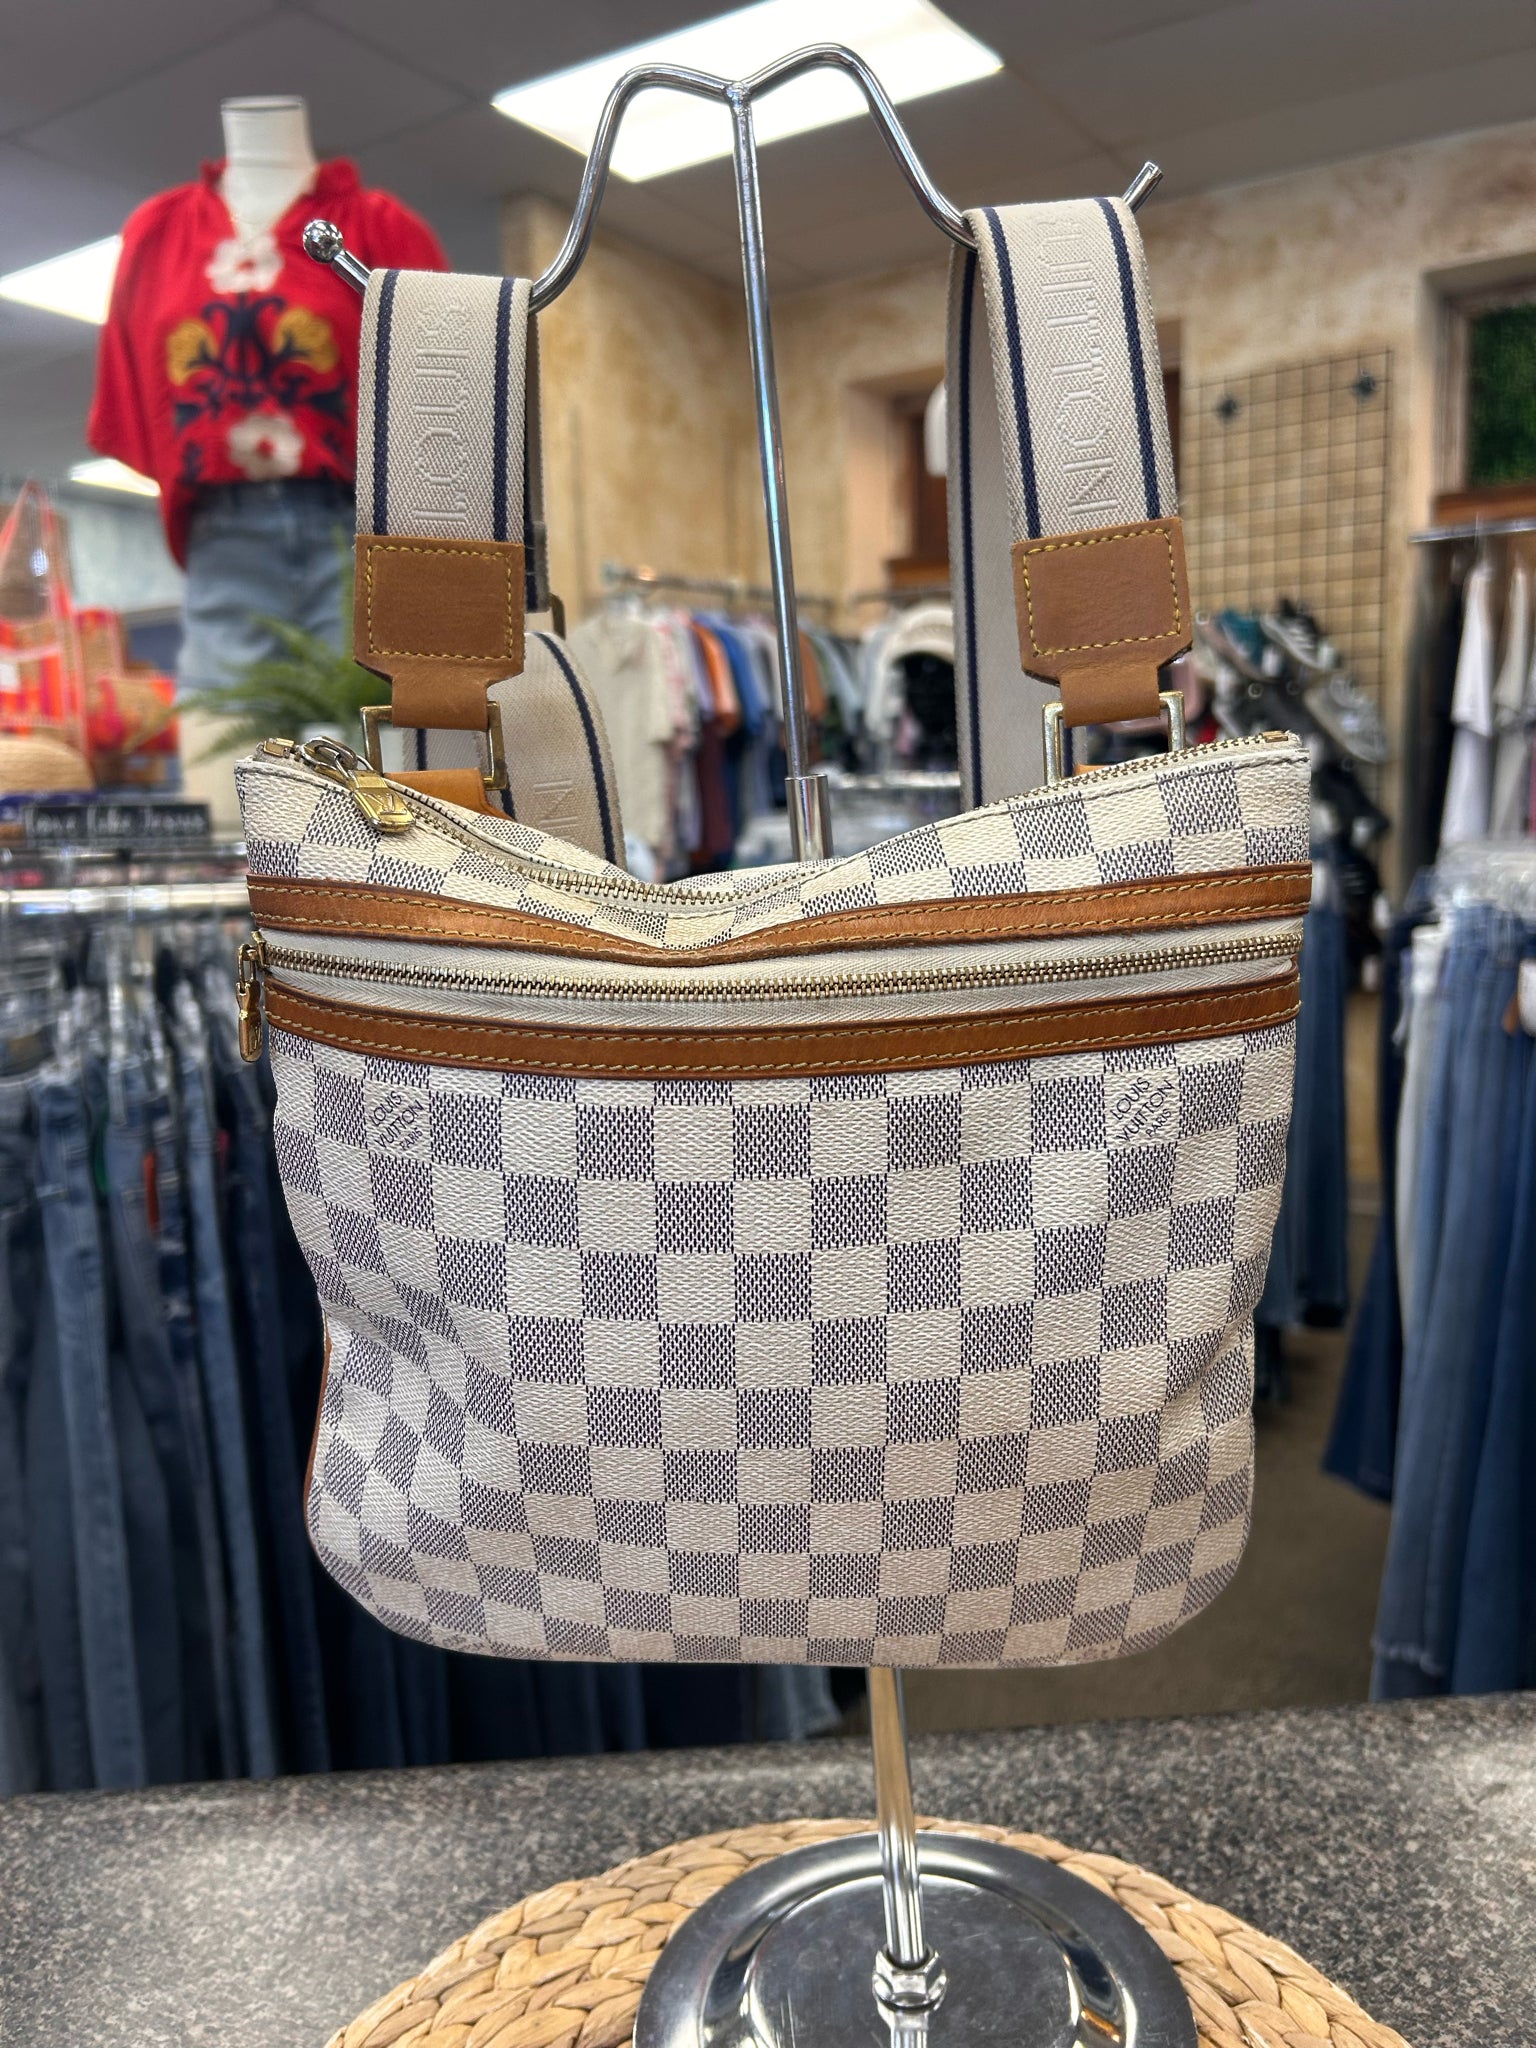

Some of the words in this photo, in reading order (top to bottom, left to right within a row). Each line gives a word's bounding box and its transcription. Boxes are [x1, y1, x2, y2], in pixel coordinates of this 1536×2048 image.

[411, 304, 472, 522] LOUIS
[369, 1090, 402, 1126] LOUIS
[1110, 1076, 1150, 1120] LOUIS
[1115, 1079, 1175, 1142] VUITTON
[373, 1099, 425, 1148] VUITTON
[400, 1127, 423, 1151] PARIS
[1145, 1108, 1172, 1137] PARIS
